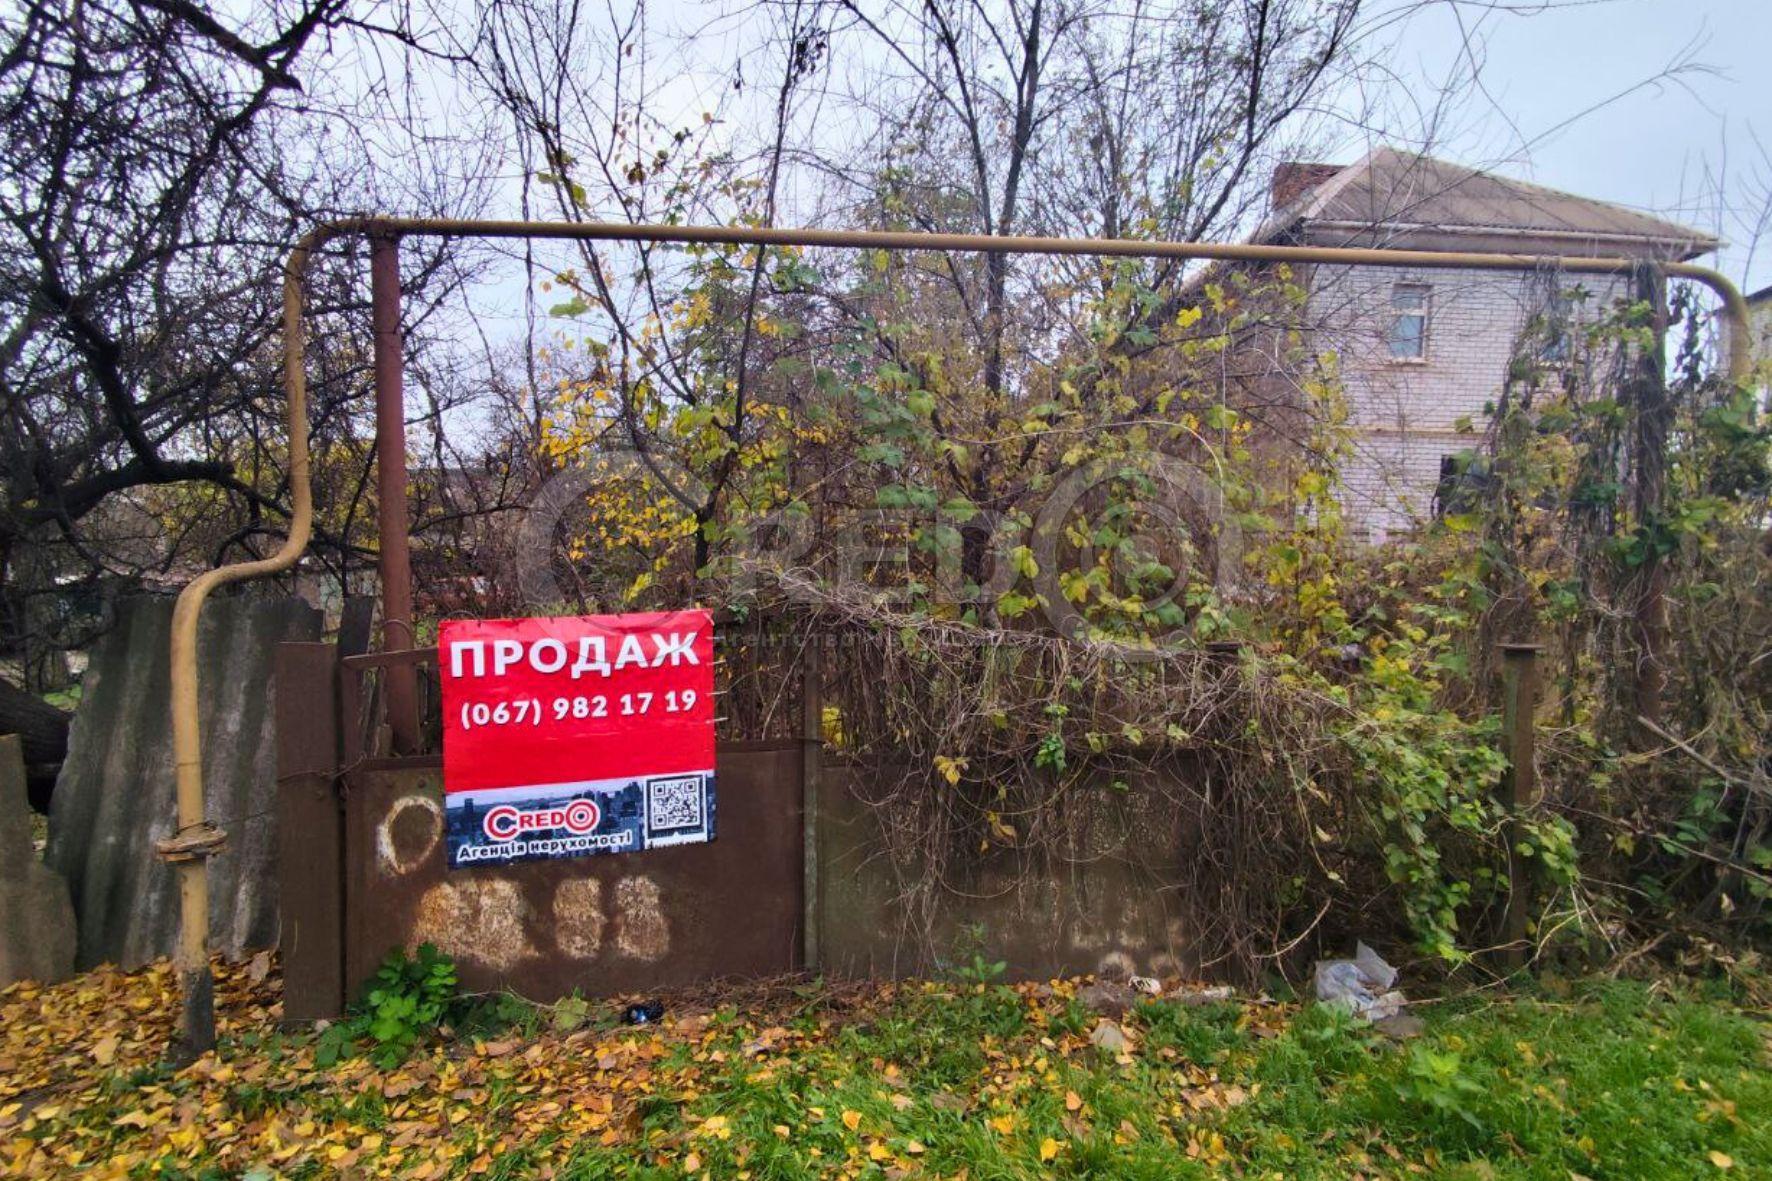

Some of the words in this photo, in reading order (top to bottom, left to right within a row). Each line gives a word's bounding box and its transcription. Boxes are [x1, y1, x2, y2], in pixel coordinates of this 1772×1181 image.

[450, 631, 700, 679] ПРОДАЖ
[461, 698, 542, 730] (067)
[553, 695, 608, 720] 982
[620, 692, 653, 716] 17
[665, 689, 698, 712] 19
[486, 800, 597, 839] CREDO
[460, 840, 525, 858] Агенція
[529, 831, 632, 853] нерухомості
